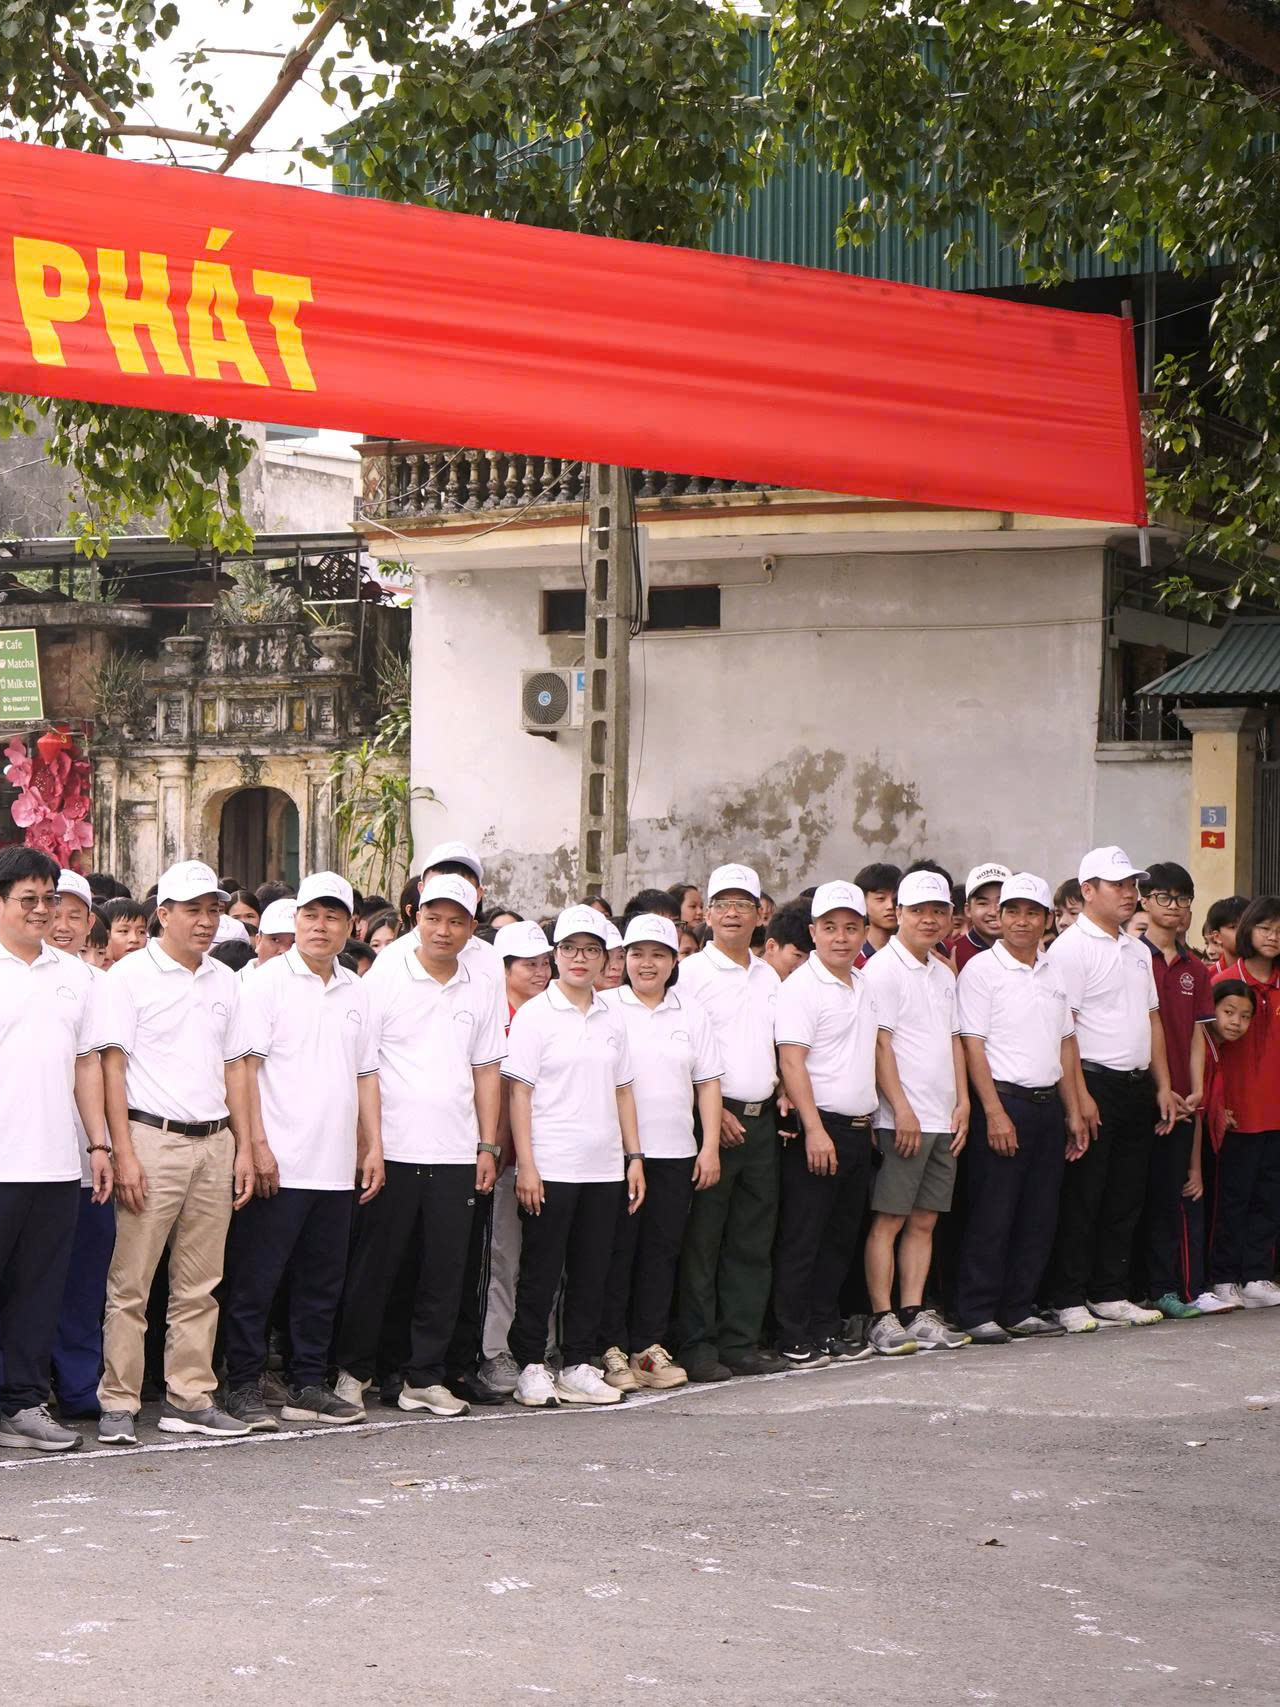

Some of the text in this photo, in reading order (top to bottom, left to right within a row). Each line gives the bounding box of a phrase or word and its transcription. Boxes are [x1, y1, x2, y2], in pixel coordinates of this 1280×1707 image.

[13, 227, 317, 391] PHÁT
[7, 659, 35, 669] Matcha
[7, 678, 37, 689] Milk tea
[1208, 809, 1217, 824] 5
